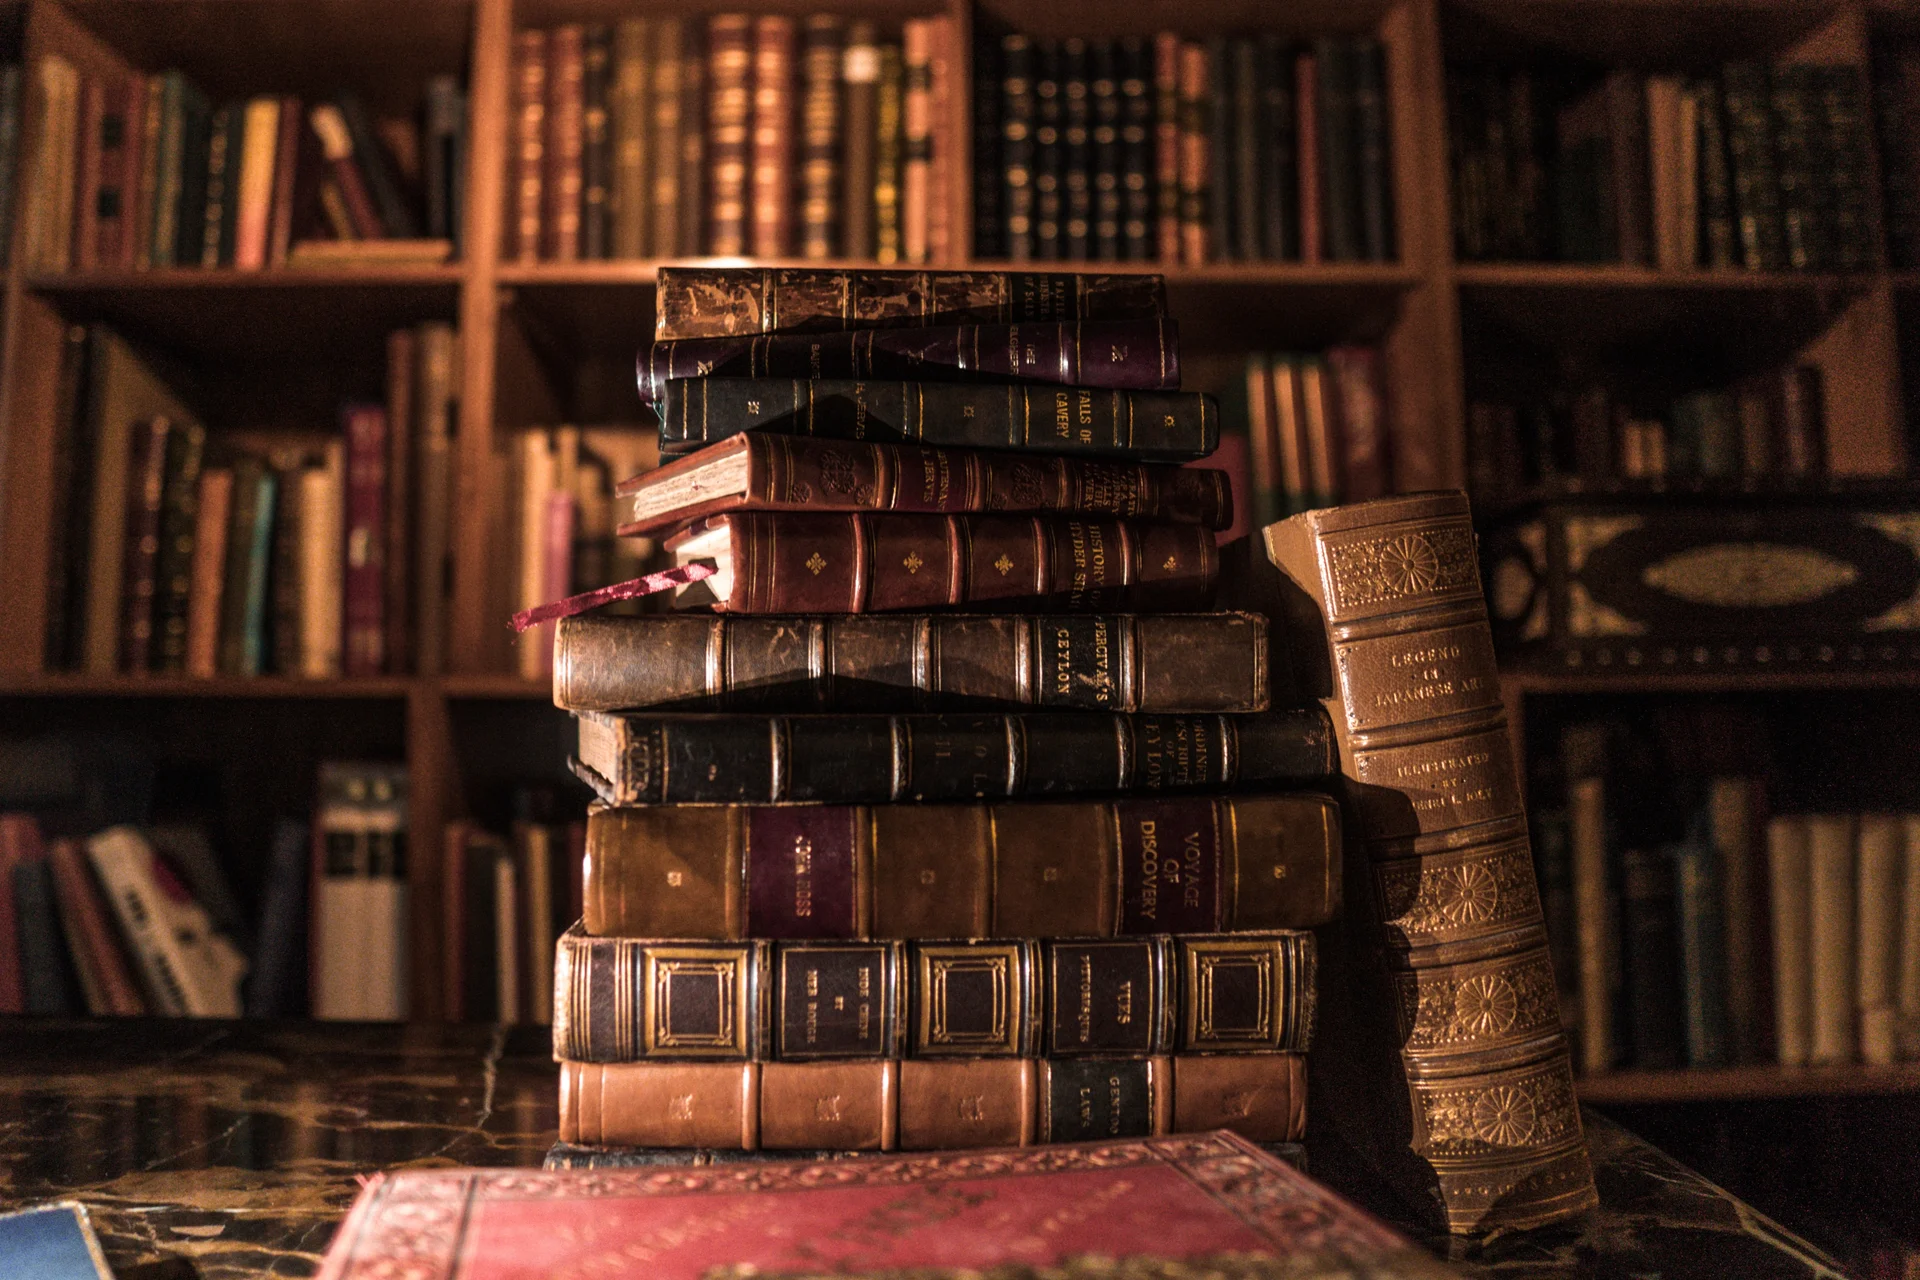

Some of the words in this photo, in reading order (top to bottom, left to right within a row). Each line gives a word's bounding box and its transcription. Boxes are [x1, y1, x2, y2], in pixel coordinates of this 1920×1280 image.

[1026, 343, 1035, 364] THE
[1056, 392, 1070, 438] CAVERY
[1079, 390, 1092, 424] FALLS
[1080, 430, 1092, 444] OF
[923, 460, 934, 503] JERVIS
[1094, 484, 1102, 508] THE
[1070, 522, 1086, 568] HYDER
[1088, 525, 1104, 585] HISTORY
[1058, 629, 1070, 694] CEYLON
[1096, 622, 1108, 702] PERCIVAL'S
[1423, 668, 1439, 681] IN
[1374, 681, 1454, 709] JAPANESE
[1166, 741, 1174, 758] OF
[1397, 752, 1490, 778] ILLUSTRATED
[1442, 777, 1458, 789] BY
[1140, 820, 1158, 920] DISCOVERY
[1163, 858, 1180, 884] OF
[1183, 832, 1201, 908] VOYAGE
[795, 880, 812, 917] ROSS
[858, 966, 870, 998] INDE
[1078, 954, 1092, 1043] PITTORESQUES
[834, 995, 844, 1012] ET
[1116, 980, 1132, 1025] VUES
[1079, 1087, 1091, 1128] LAWS
[1108, 1076, 1120, 1134] GENTOO
